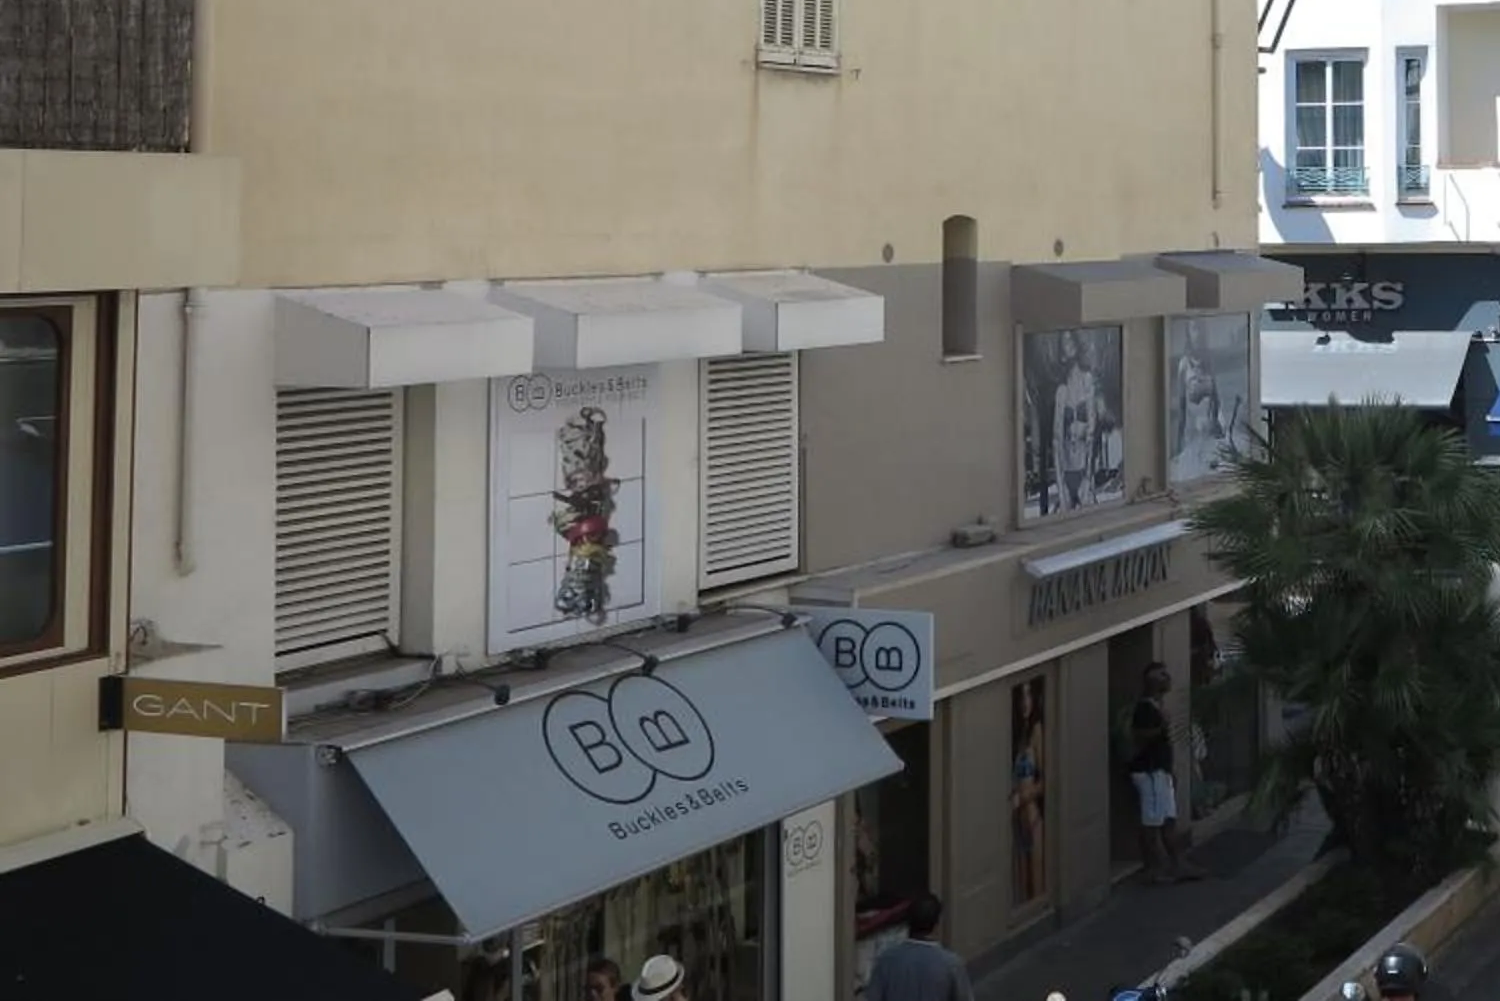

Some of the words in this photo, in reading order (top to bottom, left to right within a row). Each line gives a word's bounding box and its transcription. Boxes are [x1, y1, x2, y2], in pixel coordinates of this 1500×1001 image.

[1302, 281, 1405, 310] KKS
[133, 694, 271, 725] GANT
[608, 778, 750, 841] Buckles&Belts
